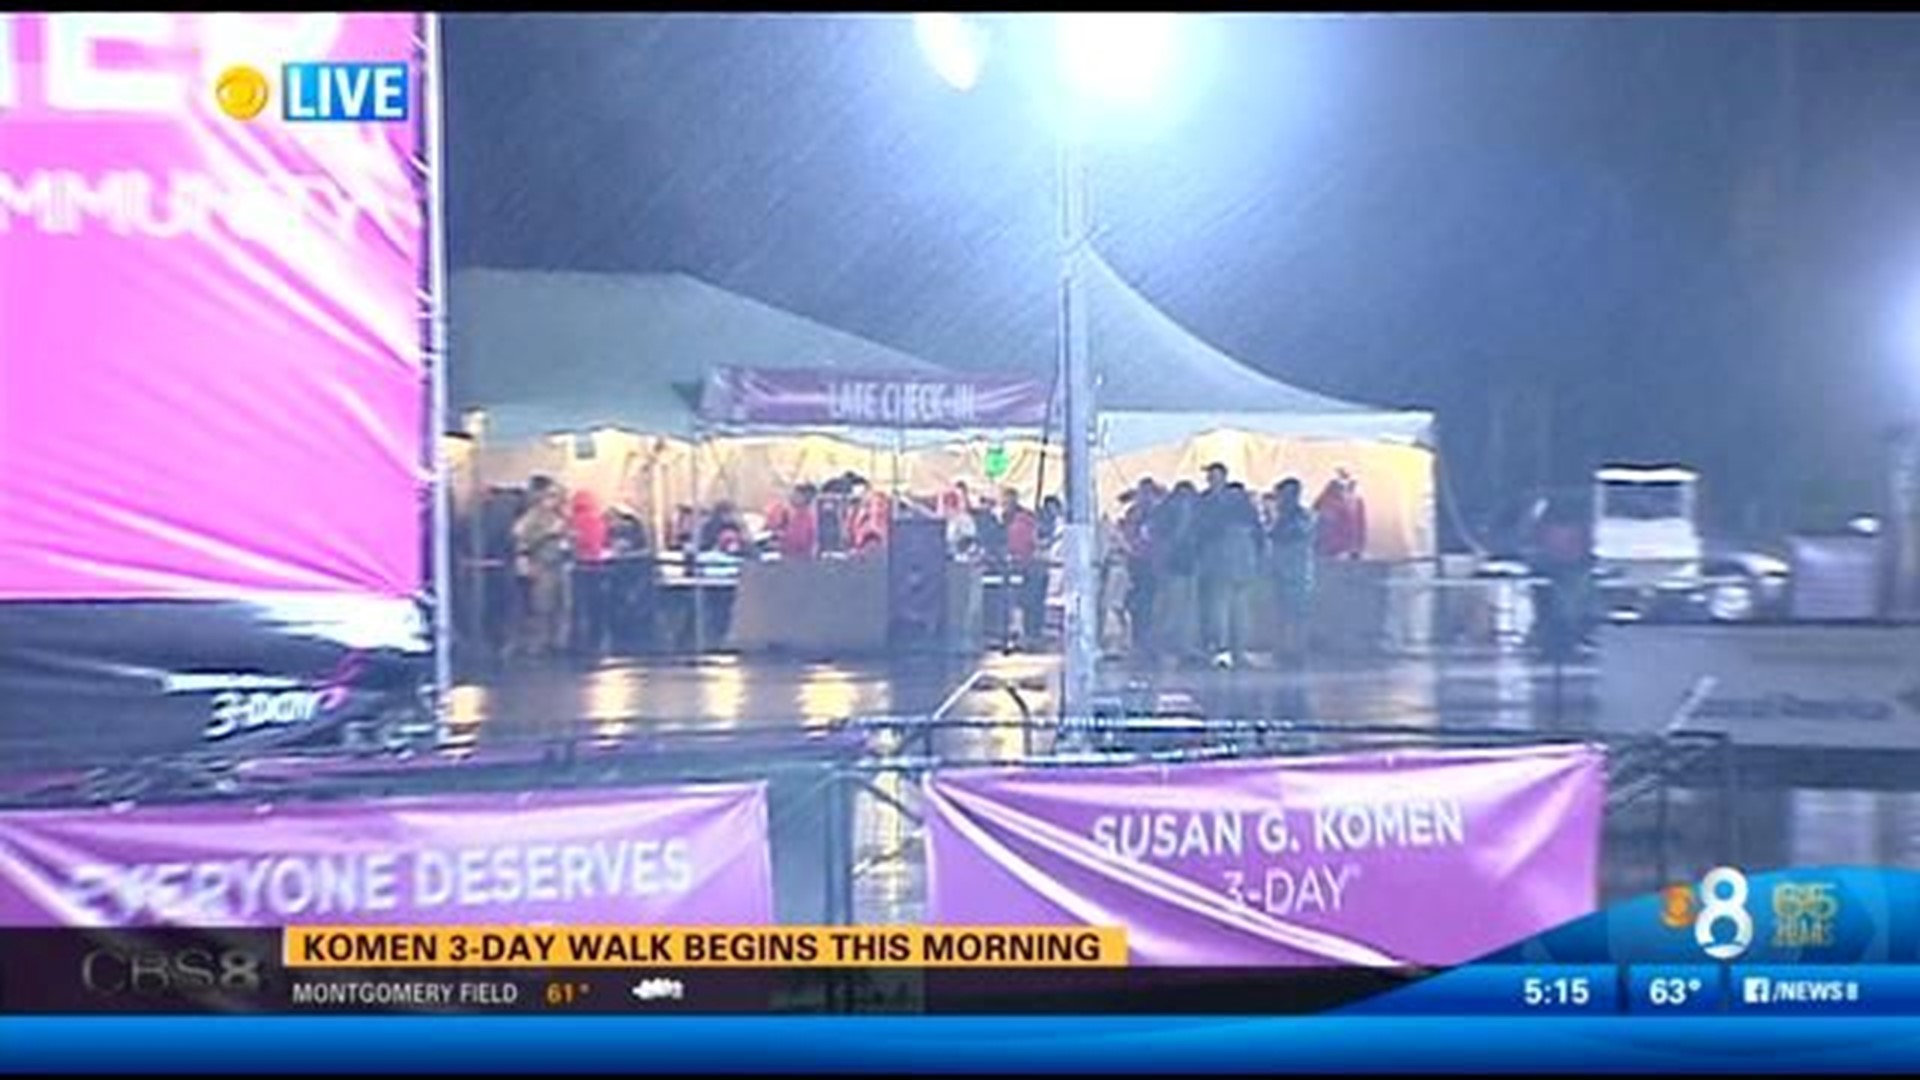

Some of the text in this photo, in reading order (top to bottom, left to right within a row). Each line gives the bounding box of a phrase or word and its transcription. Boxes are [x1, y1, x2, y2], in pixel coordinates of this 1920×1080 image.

[1093, 800, 1465, 860] SUSAN G. KOMEN
[412, 838, 693, 906] DESERVES
